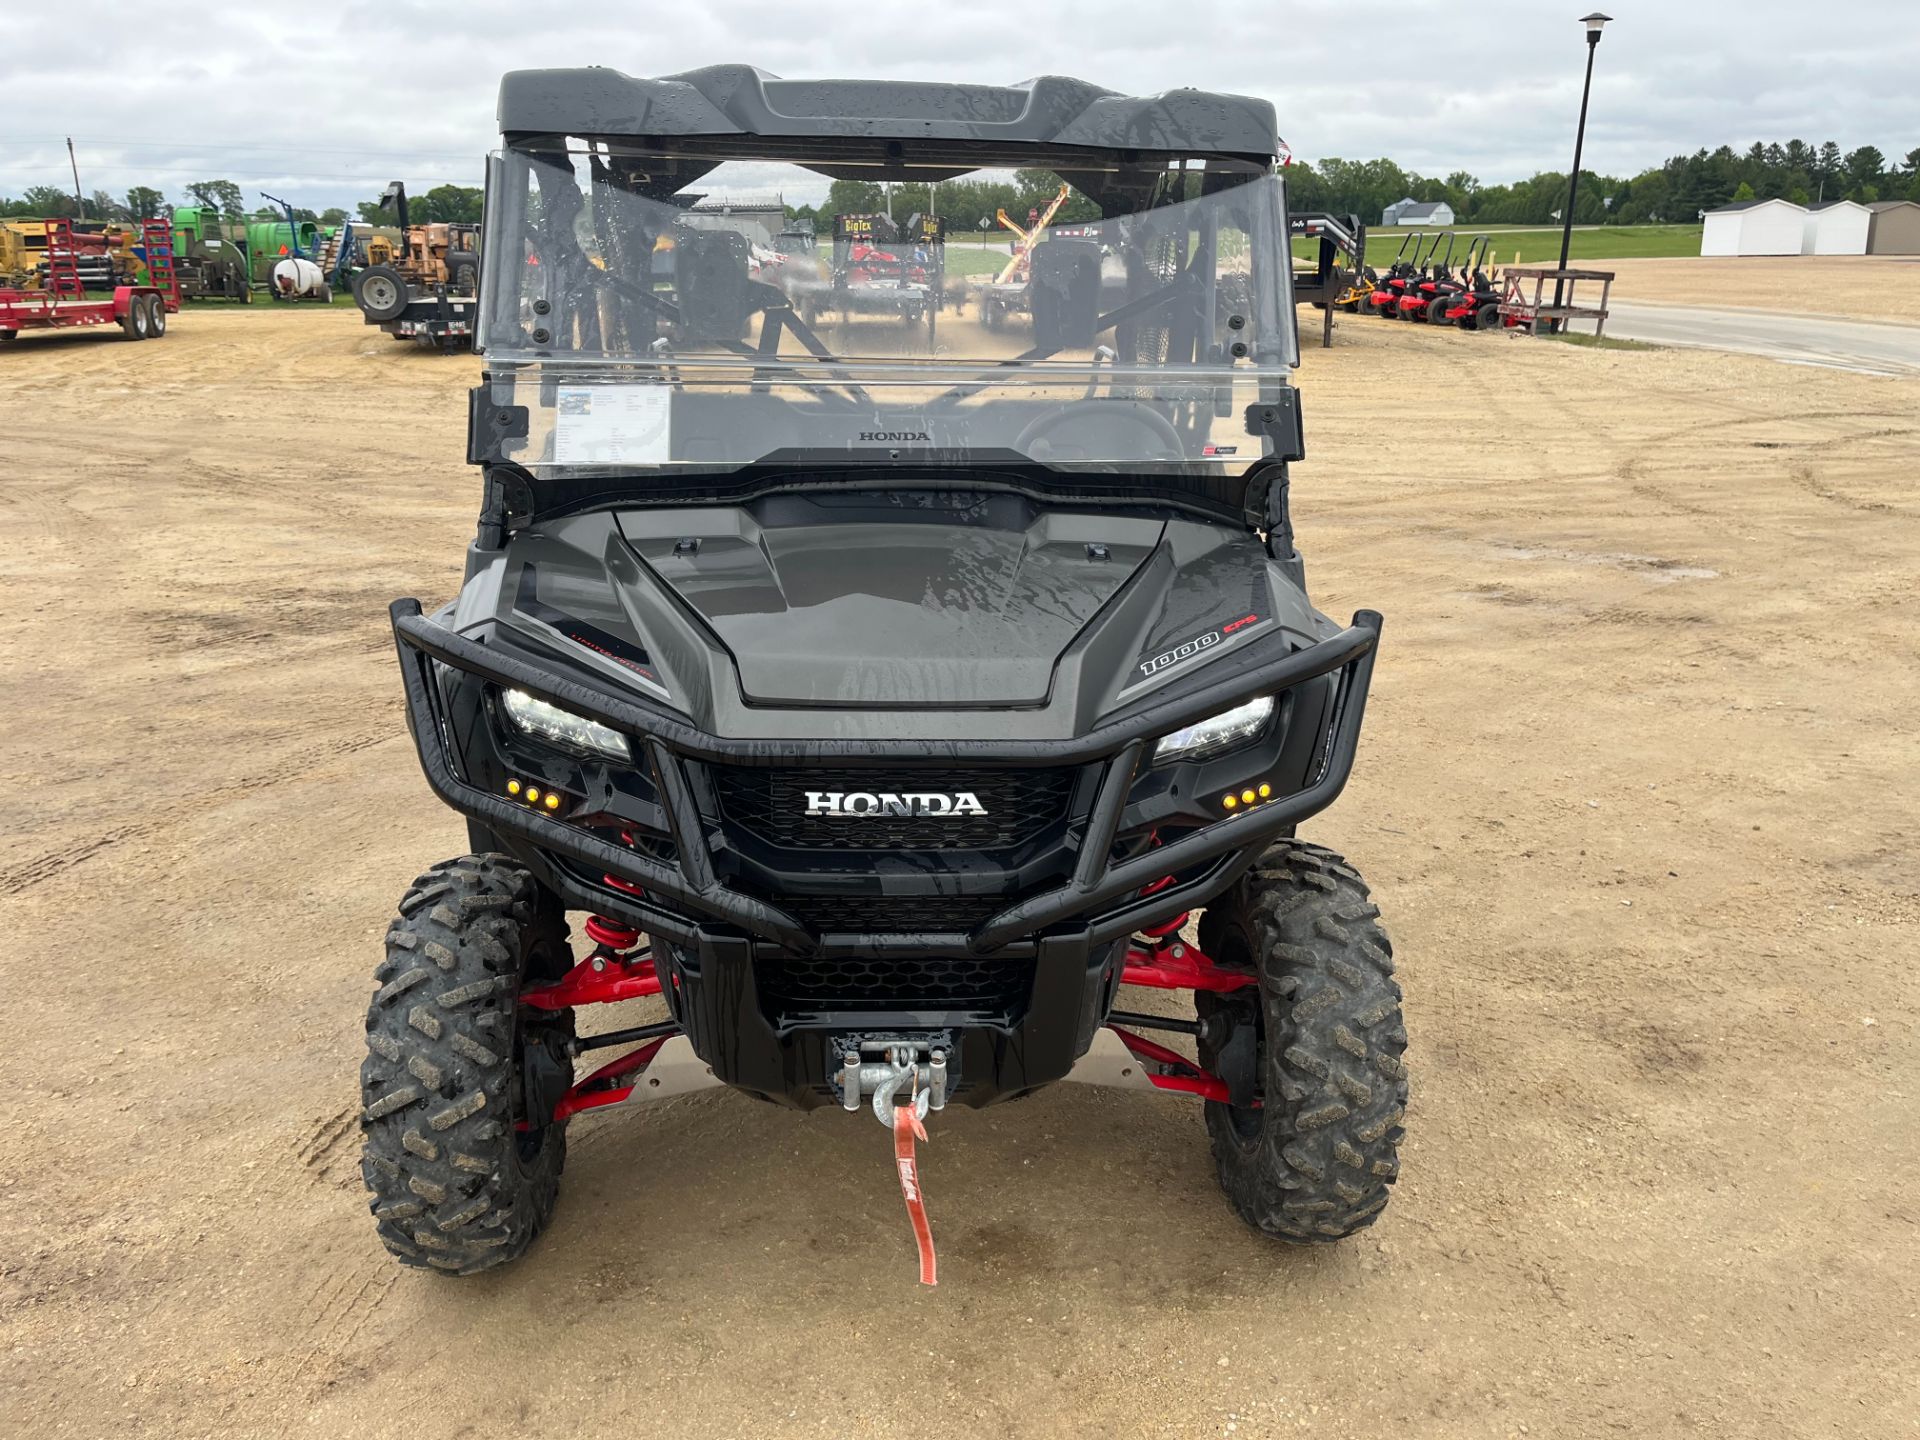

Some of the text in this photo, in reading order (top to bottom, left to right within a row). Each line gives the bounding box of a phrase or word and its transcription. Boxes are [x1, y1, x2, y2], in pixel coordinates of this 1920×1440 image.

[859, 431, 931, 441] HONDA
[1140, 614, 1257, 676] 1000 EPS
[804, 791, 989, 817] HONDA
